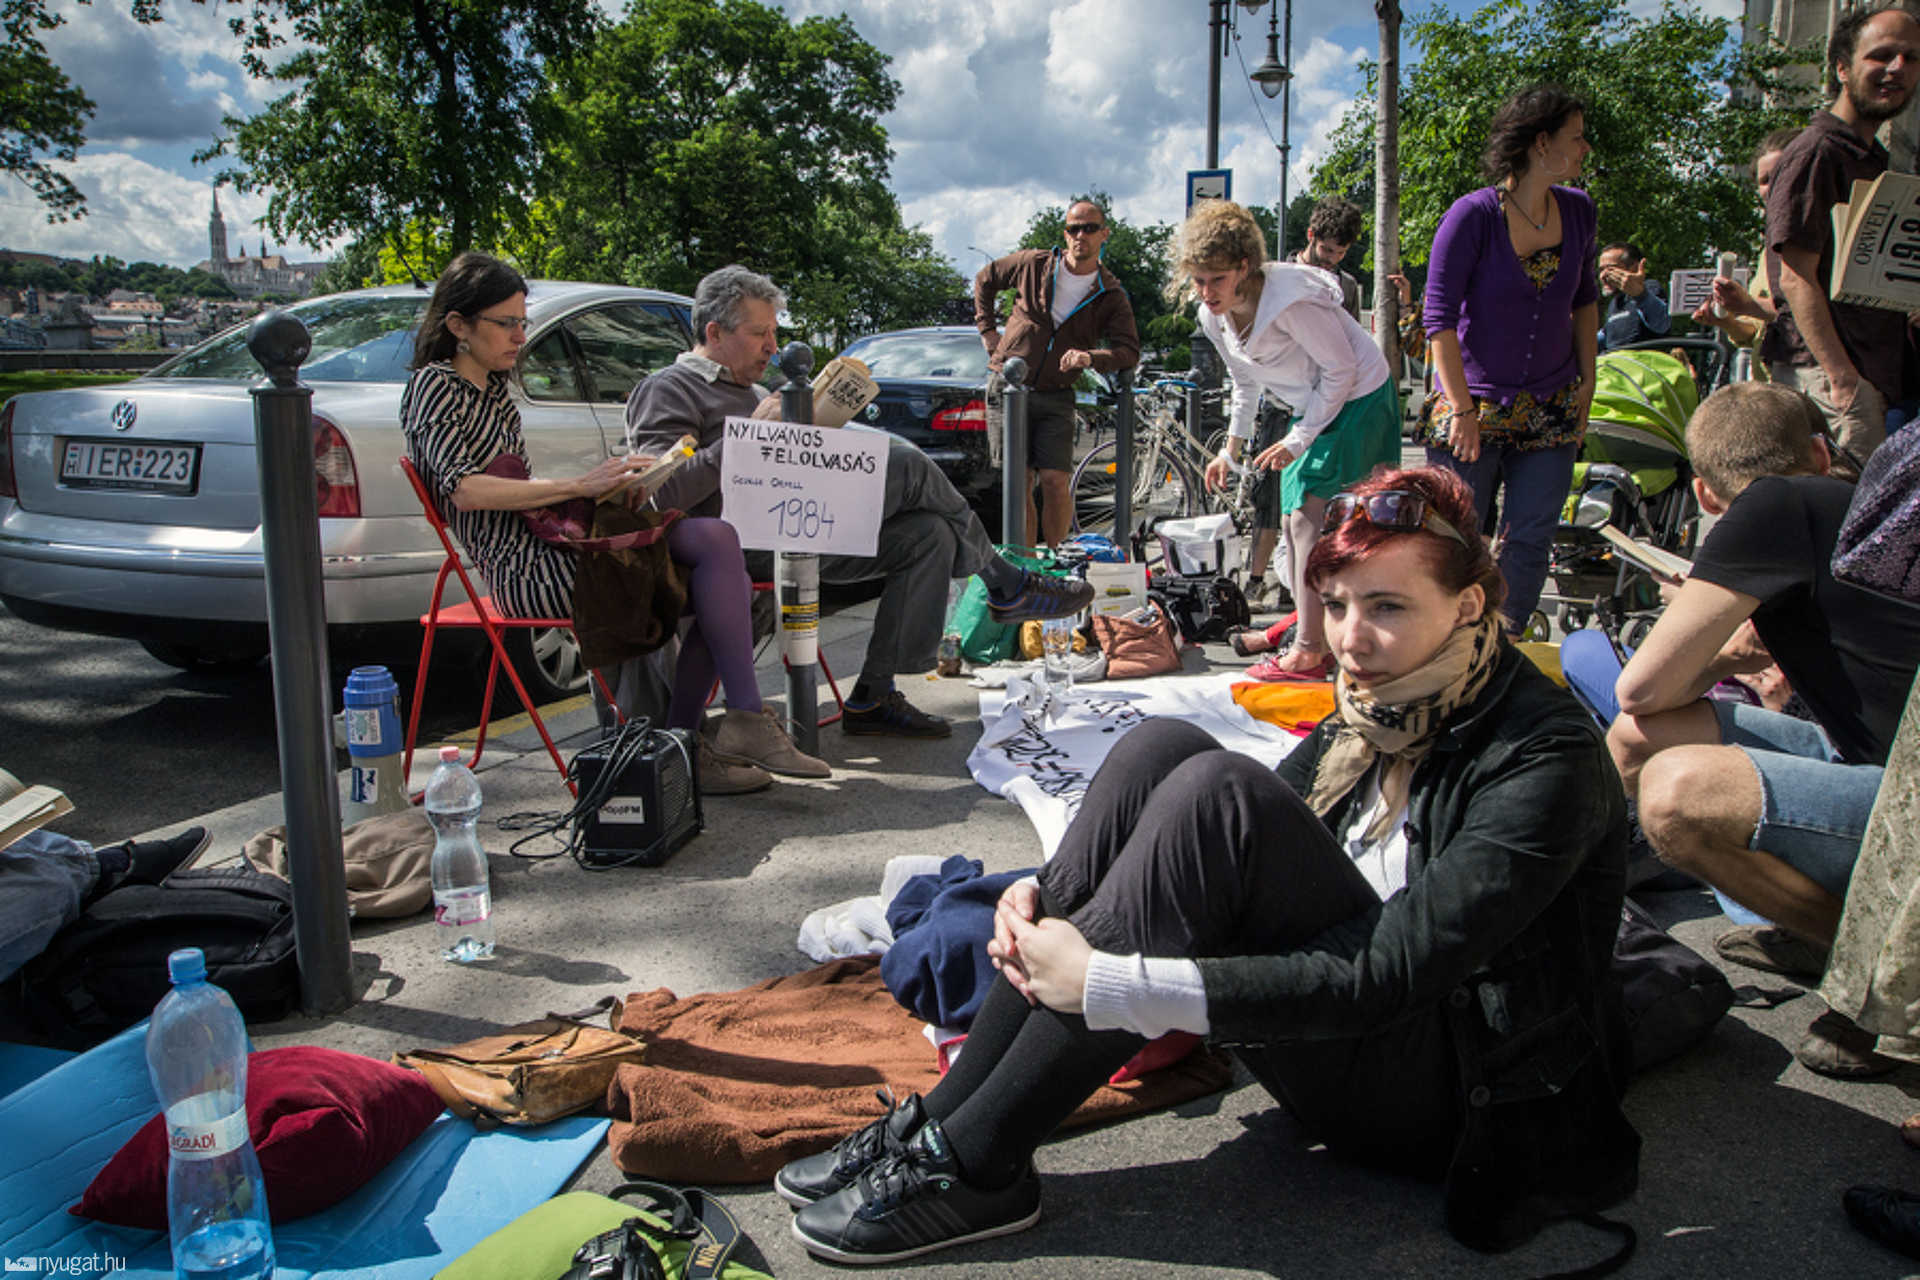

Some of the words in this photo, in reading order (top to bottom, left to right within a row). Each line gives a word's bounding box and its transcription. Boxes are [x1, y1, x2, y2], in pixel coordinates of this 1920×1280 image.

[1855, 200, 1895, 265] ORWELL
[727, 422, 824, 447] NYILVÁNOS
[760, 446, 876, 474] FELOLVASÁS
[767, 498, 835, 540] 1984
